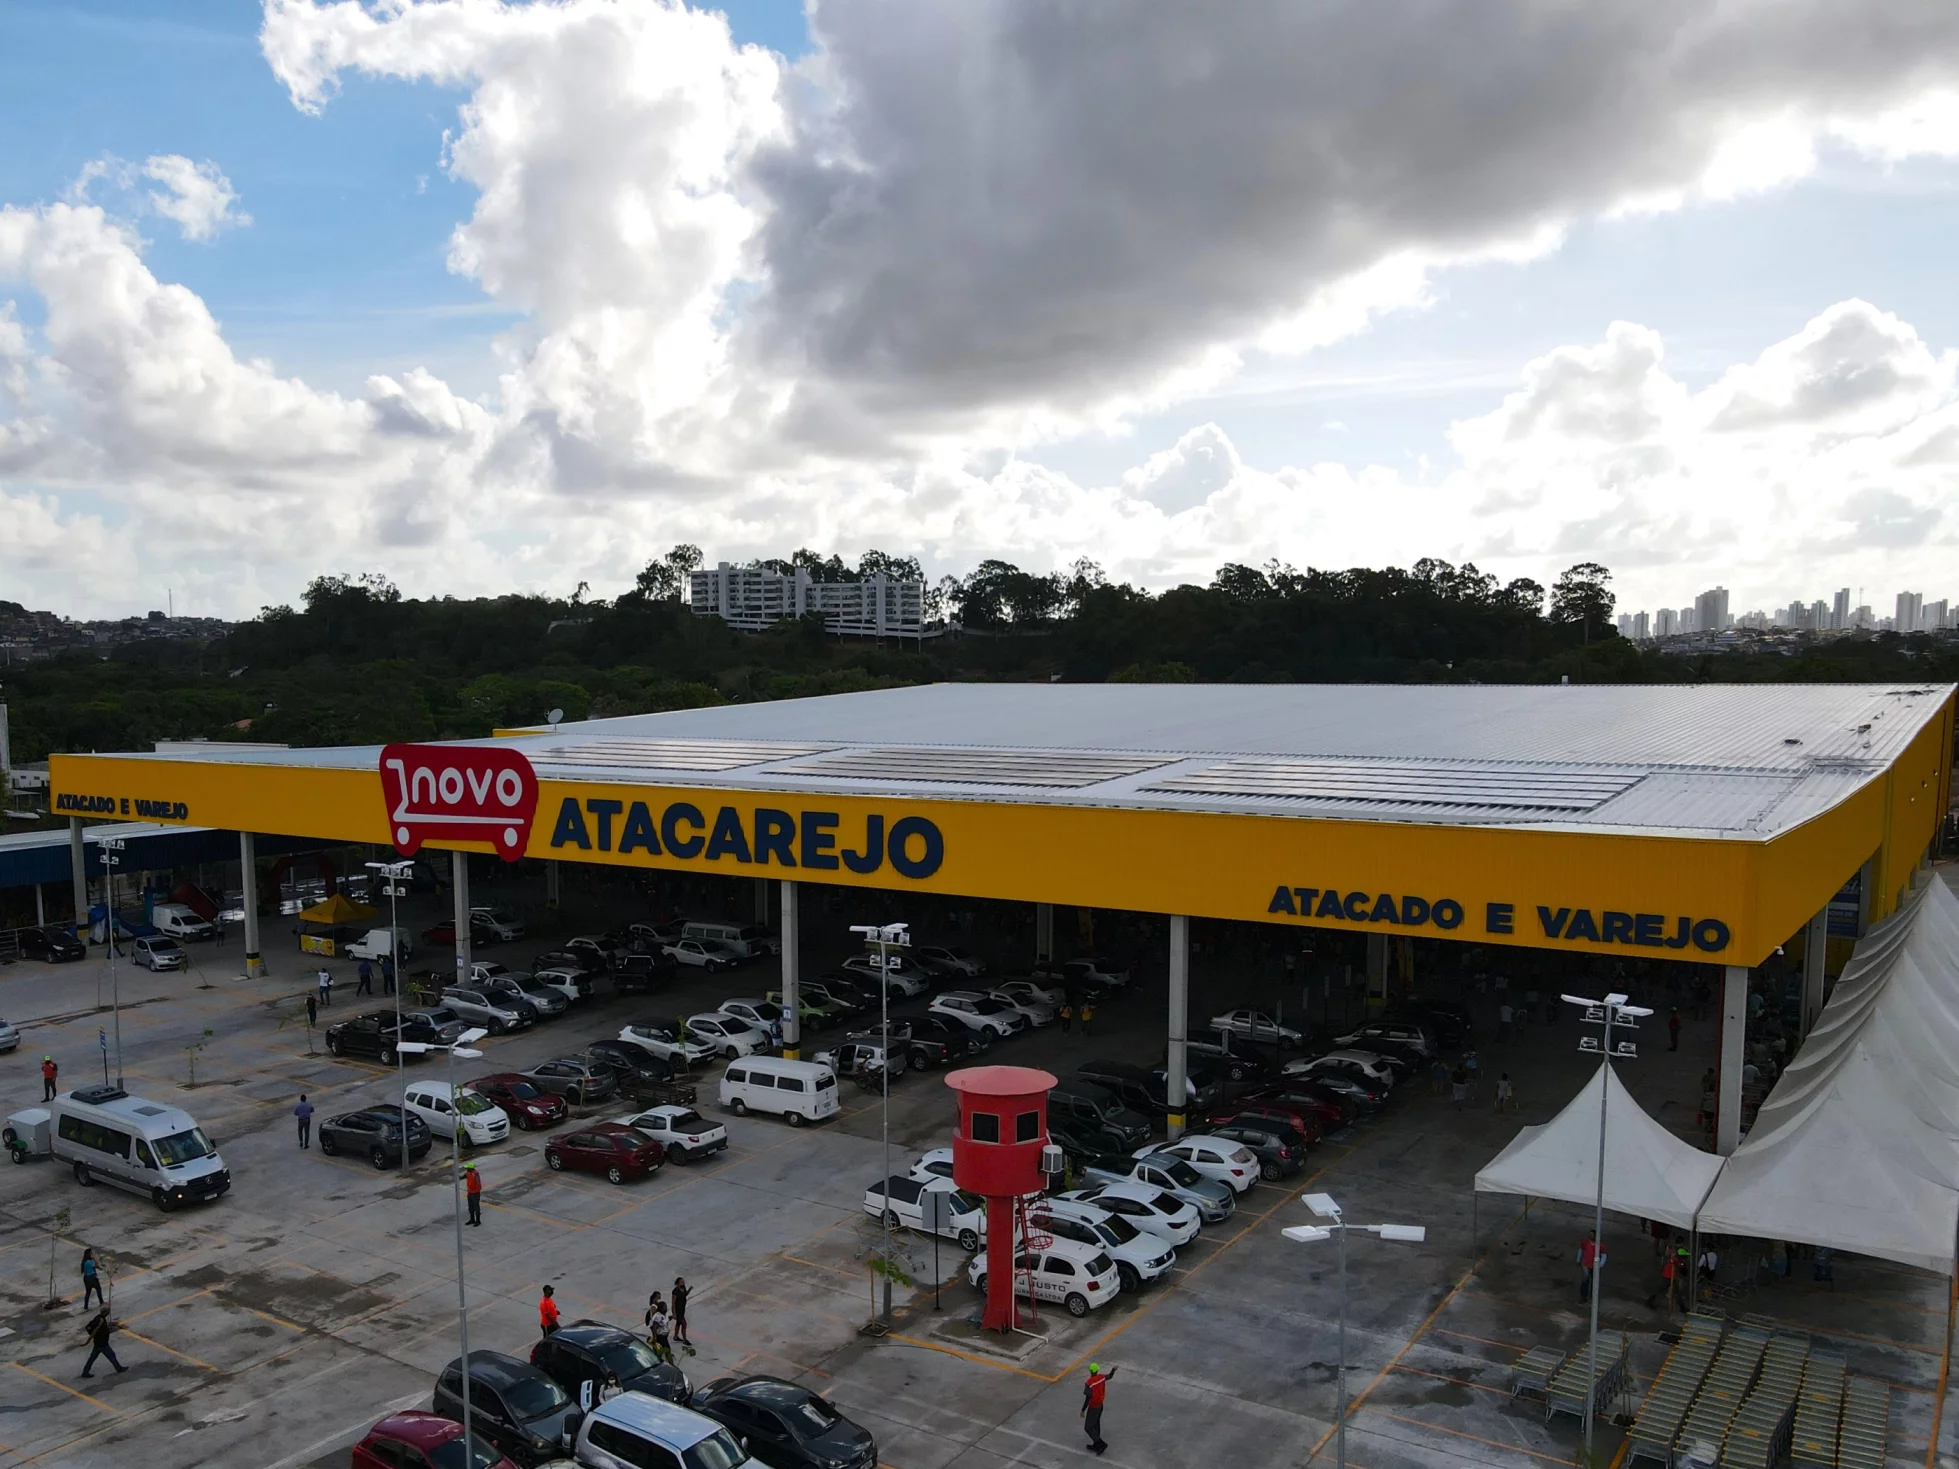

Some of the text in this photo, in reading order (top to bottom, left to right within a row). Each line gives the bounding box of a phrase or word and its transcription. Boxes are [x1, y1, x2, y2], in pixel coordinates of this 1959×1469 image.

[56, 793, 188, 820] ATACADO E VAREJO
[552, 798, 943, 878] ATACAREJO
[1268, 886, 1731, 952] ATACADO E VAREJO
